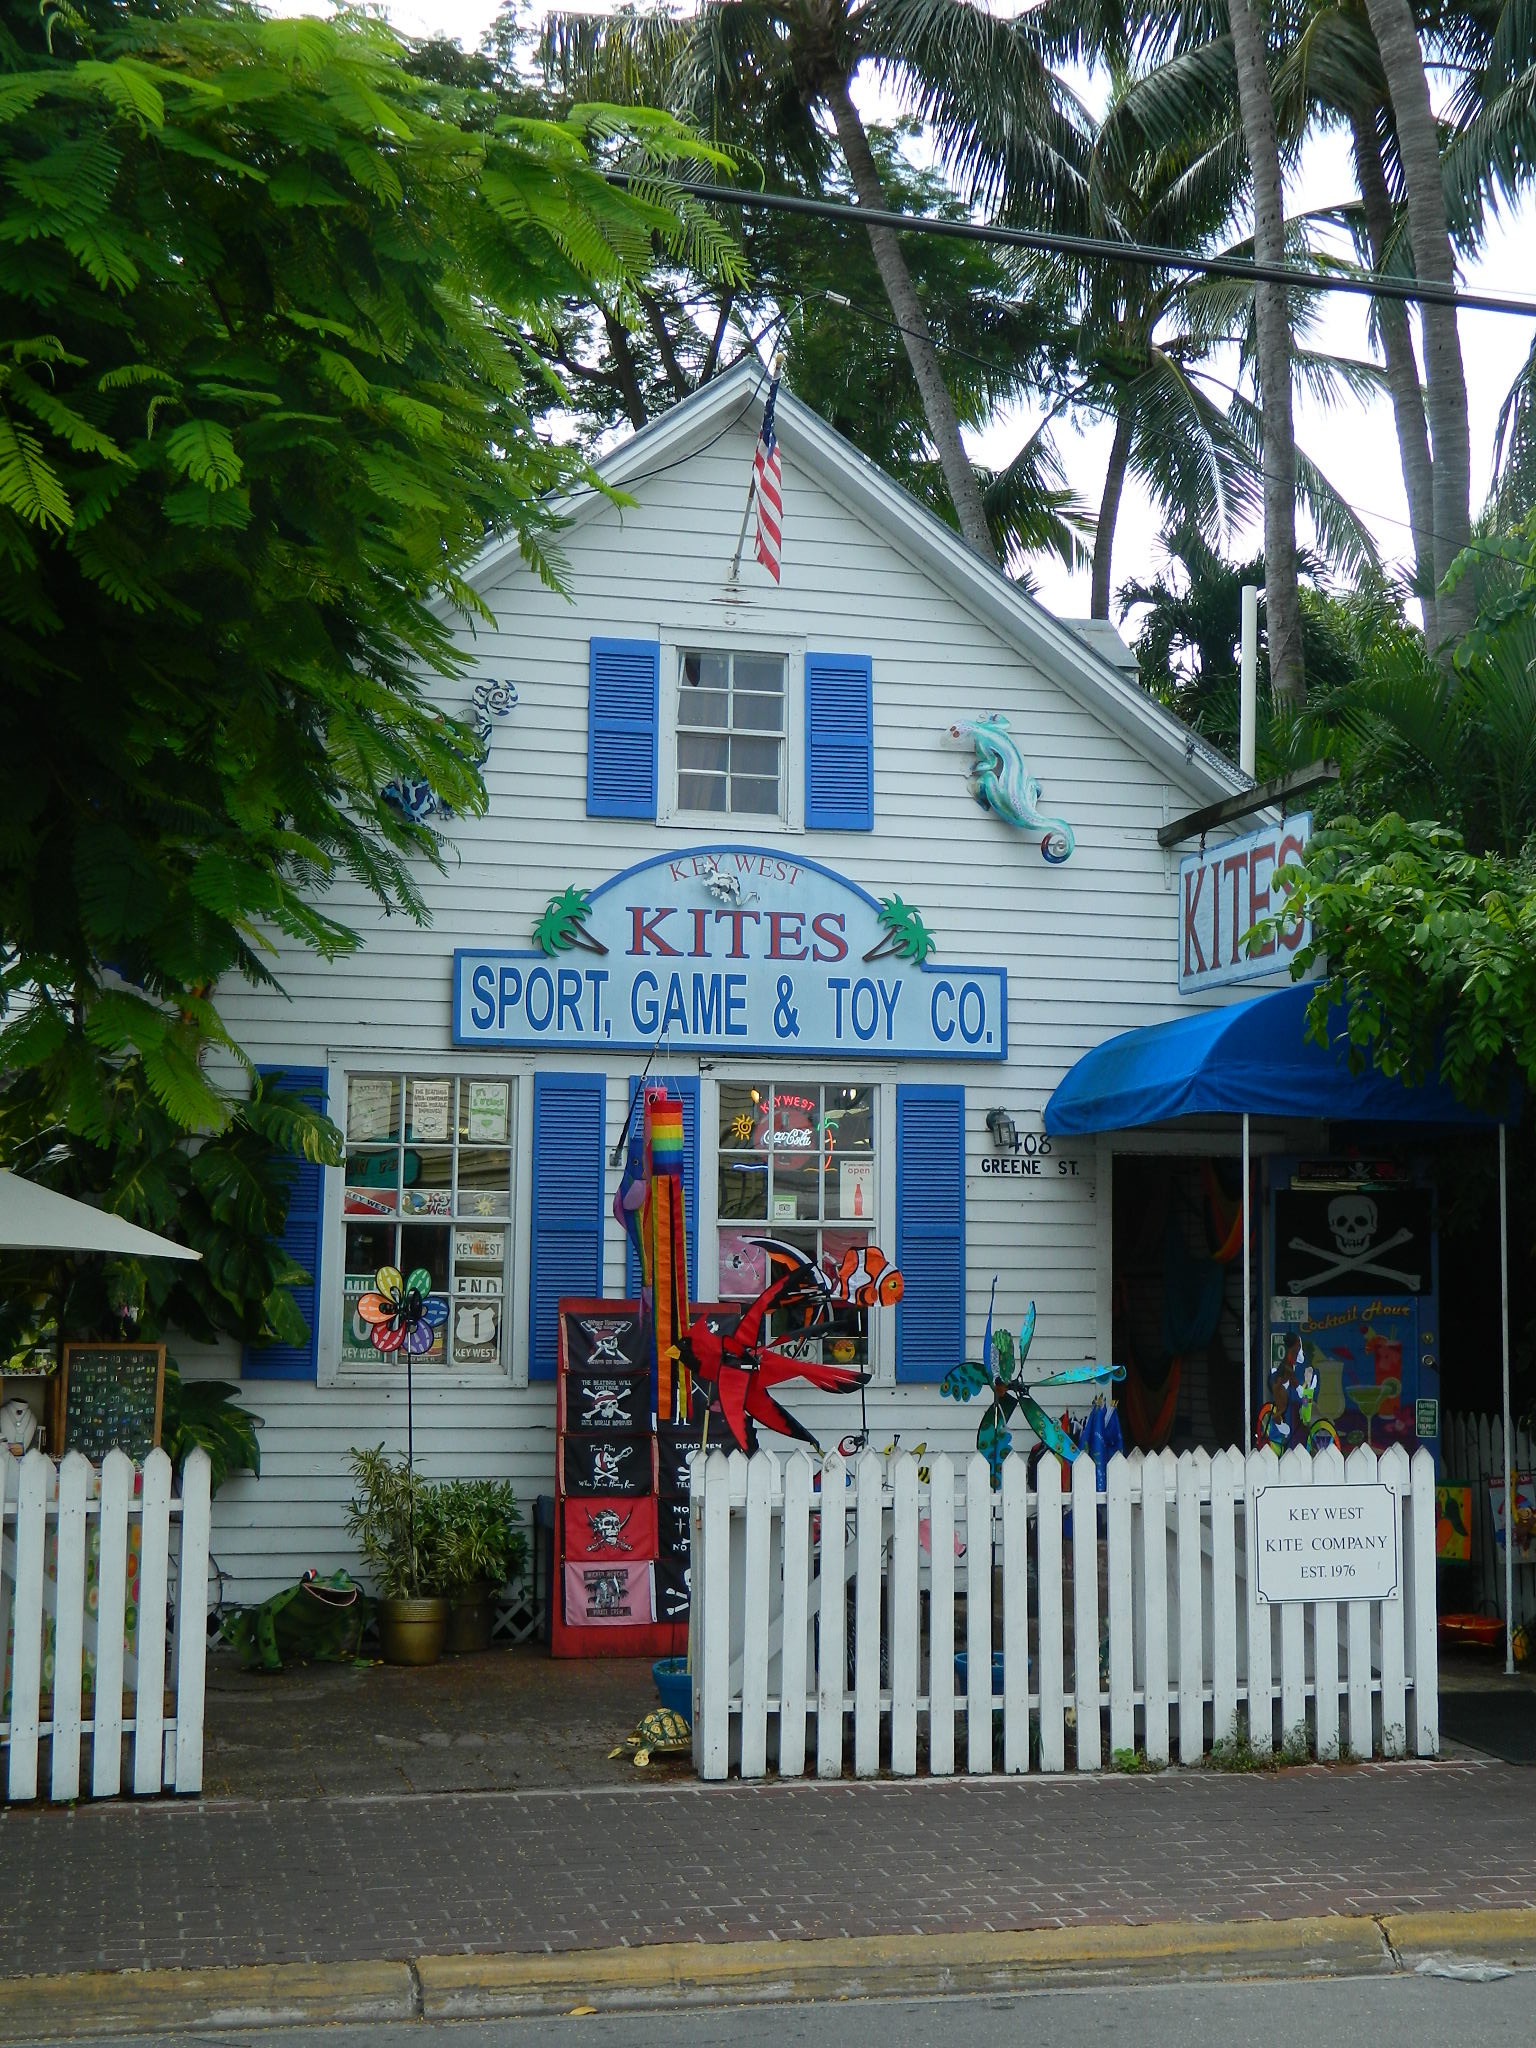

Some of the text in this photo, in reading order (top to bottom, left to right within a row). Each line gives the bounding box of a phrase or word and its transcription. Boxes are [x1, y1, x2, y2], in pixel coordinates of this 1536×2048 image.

[668, 854, 804, 885] KEY WEST
[1183, 834, 1304, 977] KITES
[625, 906, 849, 963] KITES
[471, 965, 993, 1044] SPORT, GAME & TOY CO.
[760, 1096, 815, 1114] KY WEST
[1009, 1132, 1052, 1156] 408
[981, 1158, 1080, 1175] GREENE ST.
[367, 1199, 393, 1214] WEST
[428, 1192, 451, 1207] Key
[456, 1243, 501, 1256] KEY WEST
[1299, 1300, 1409, 1333] Cocktail Hour
[472, 1313, 480, 1339] 1
[342, 1348, 382, 1359] KEY WEST
[455, 1348, 496, 1358] KEY WEST
[780, 1344, 810, 1357] KW
[1289, 1507, 1364, 1521] KEY WEST
[1266, 1535, 1388, 1552] KITE COMPANY
[1301, 1564, 1356, 1579] EST. 1976
